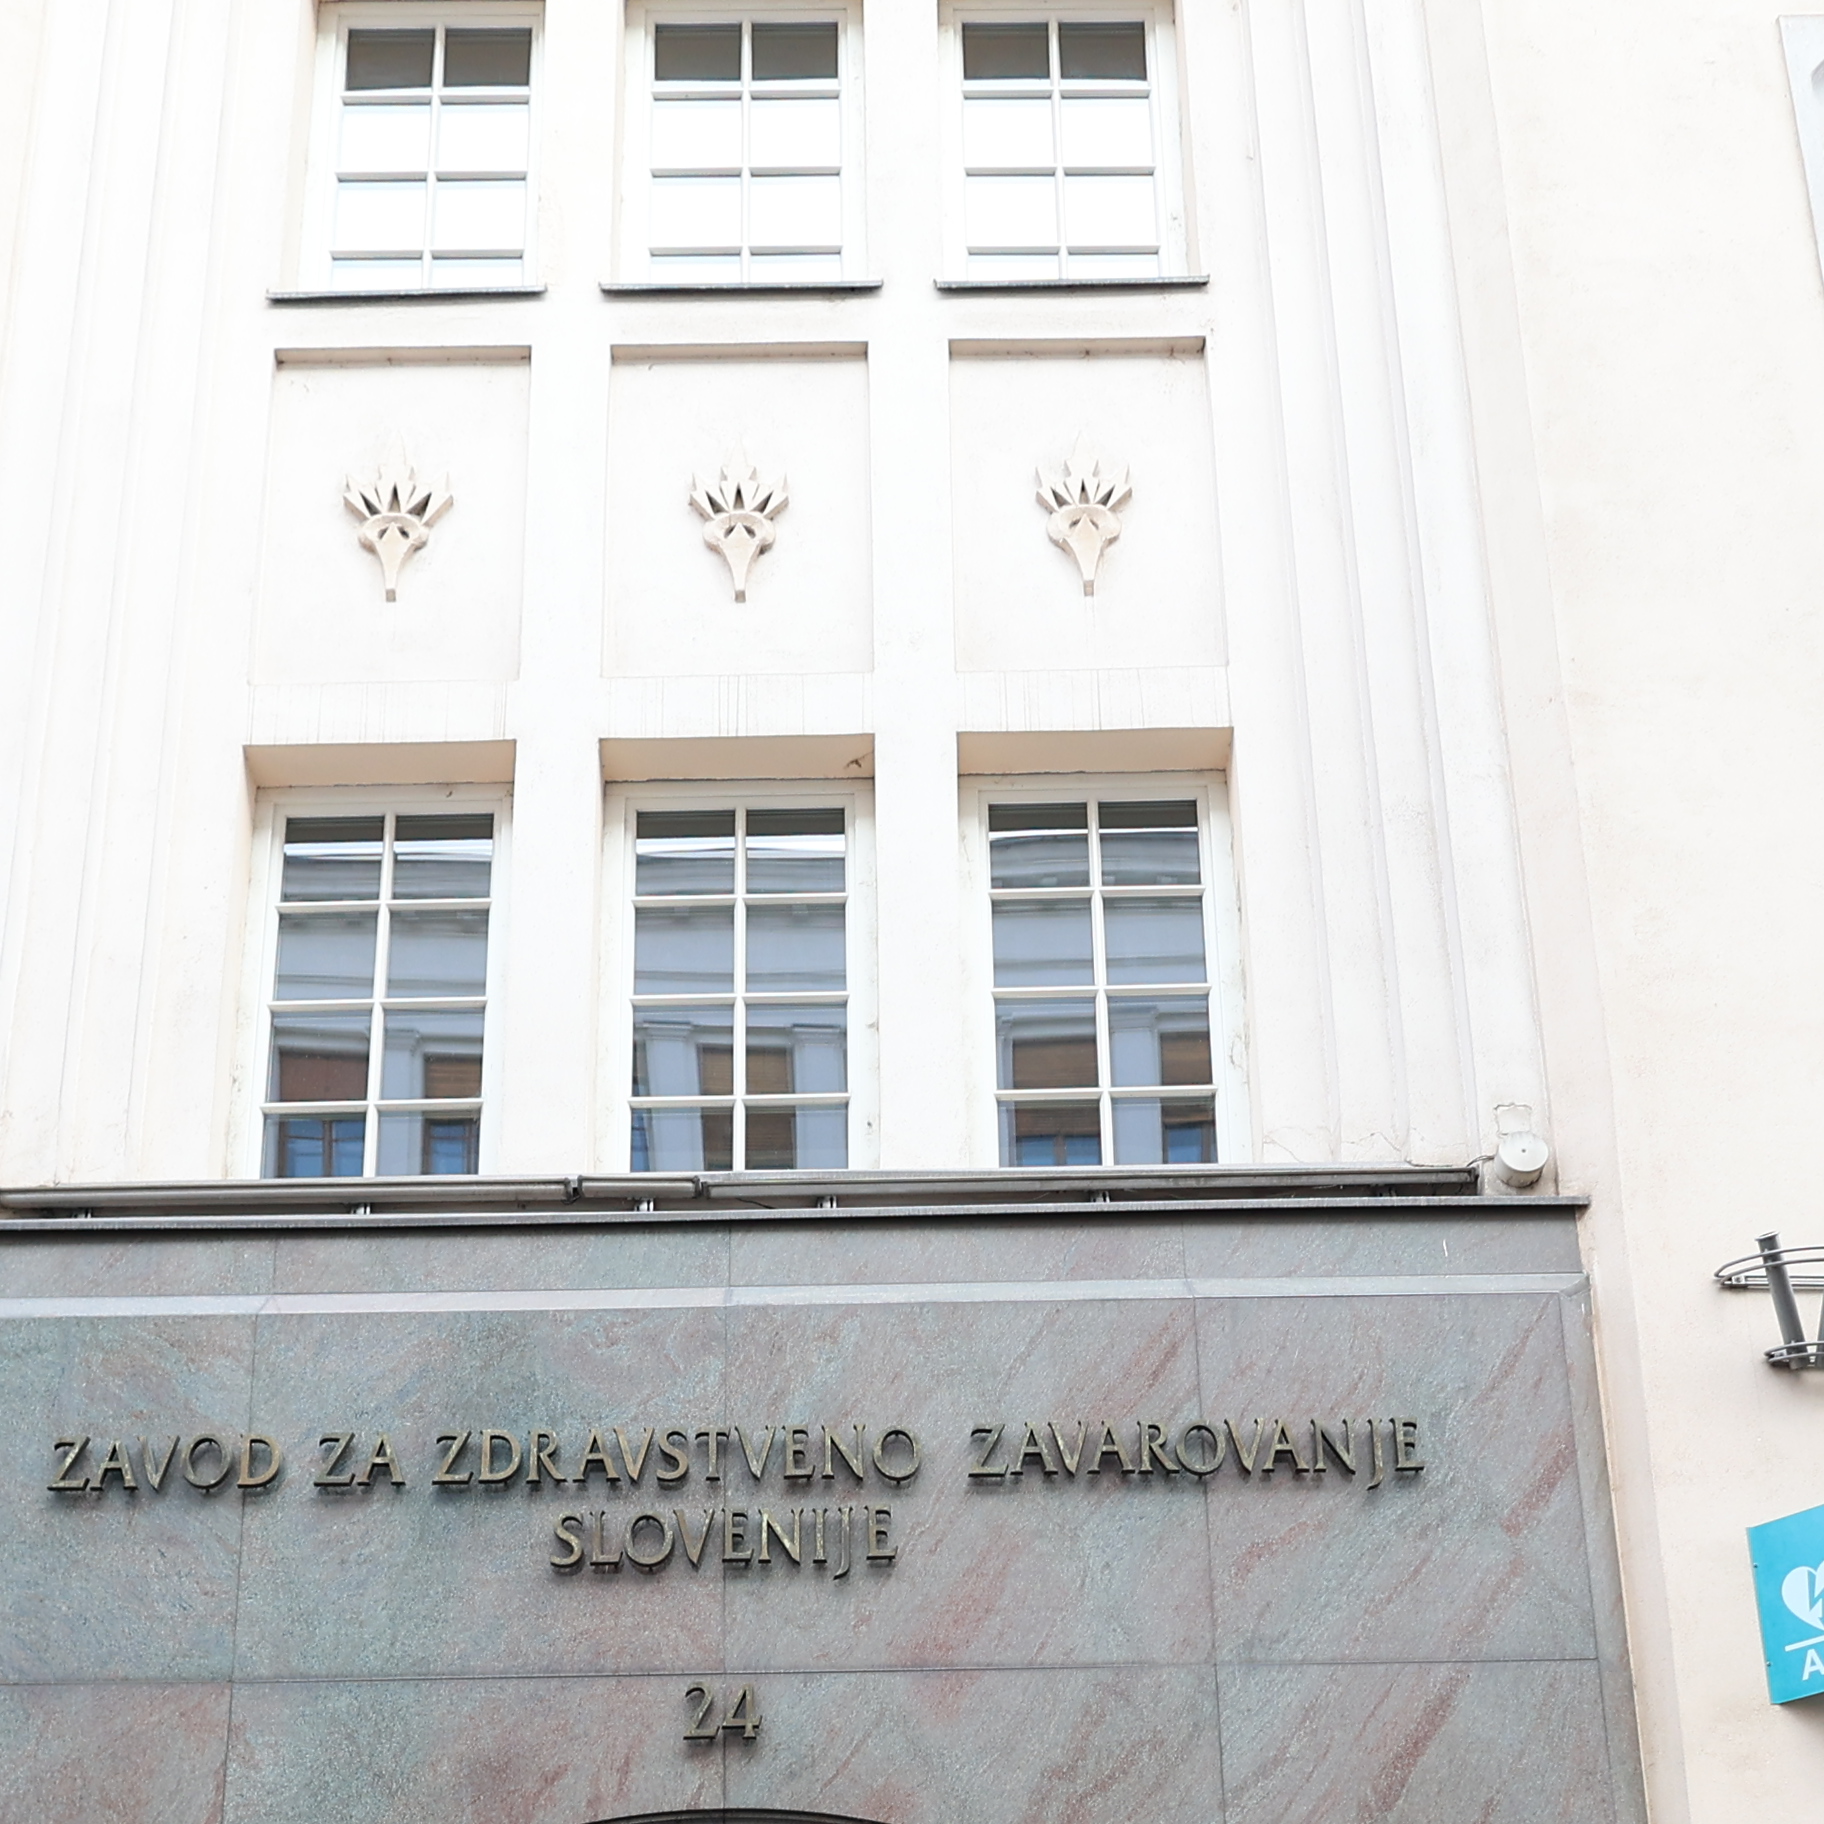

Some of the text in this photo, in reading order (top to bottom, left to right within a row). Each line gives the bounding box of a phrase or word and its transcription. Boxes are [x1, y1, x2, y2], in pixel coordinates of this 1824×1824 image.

[46, 1417, 1425, 1491] ZAVOD ZA ZDRAVSTVENO ZAVAROVANJE
[549, 1504, 899, 1580] SLOVENIJE
[683, 1681, 763, 1740] 24
